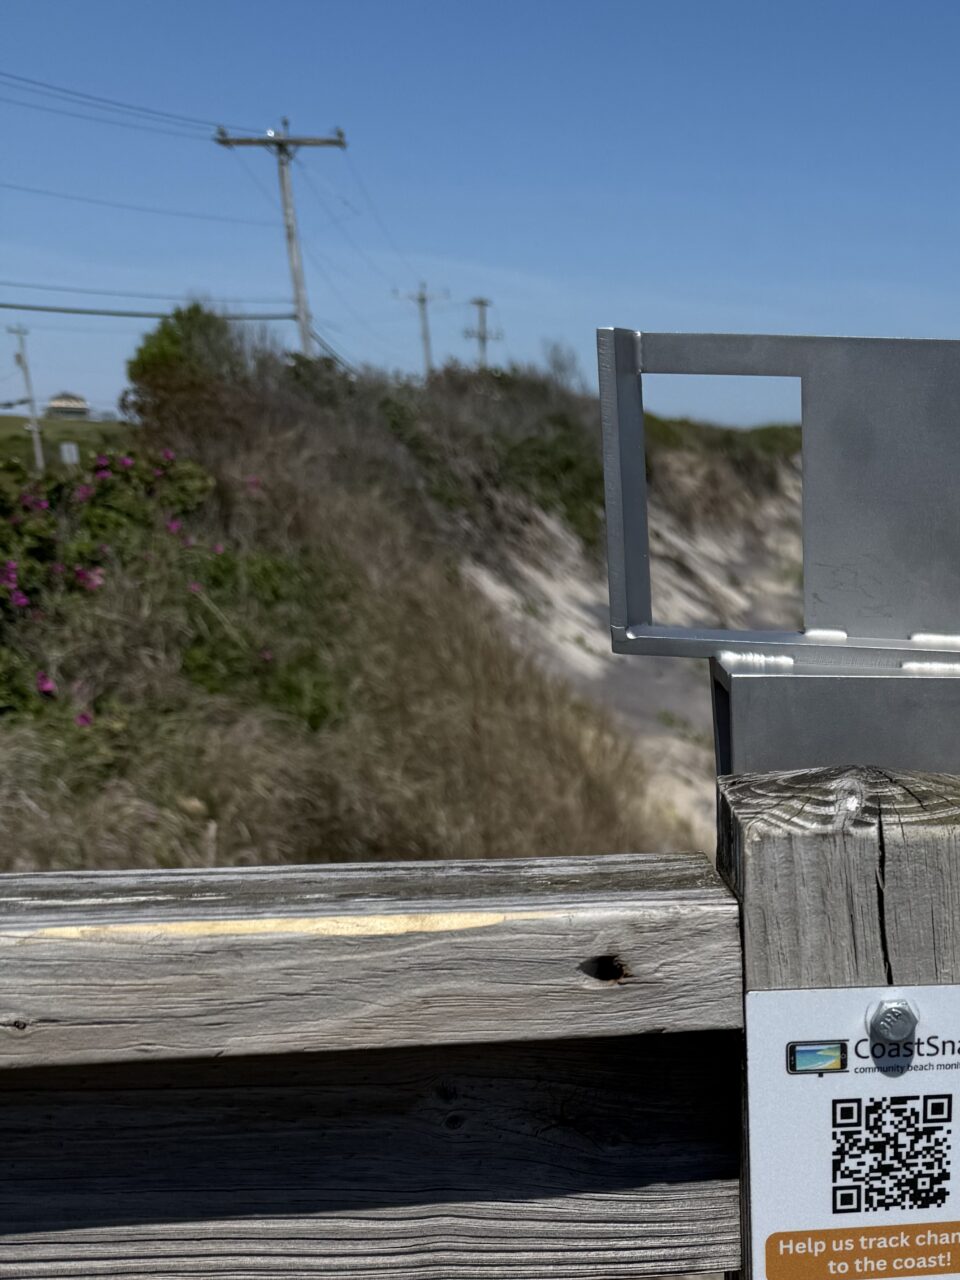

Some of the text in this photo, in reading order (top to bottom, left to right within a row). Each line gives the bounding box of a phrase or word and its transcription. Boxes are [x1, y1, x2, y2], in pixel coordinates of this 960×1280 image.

[854, 1064, 905, 1074] community
[907, 1063, 935, 1071] beach
[779, 1239, 825, 1256] Help
[832, 1237, 854, 1252] us
[860, 1232, 909, 1249] track
[828, 1252, 951, 1274] to the coast!
